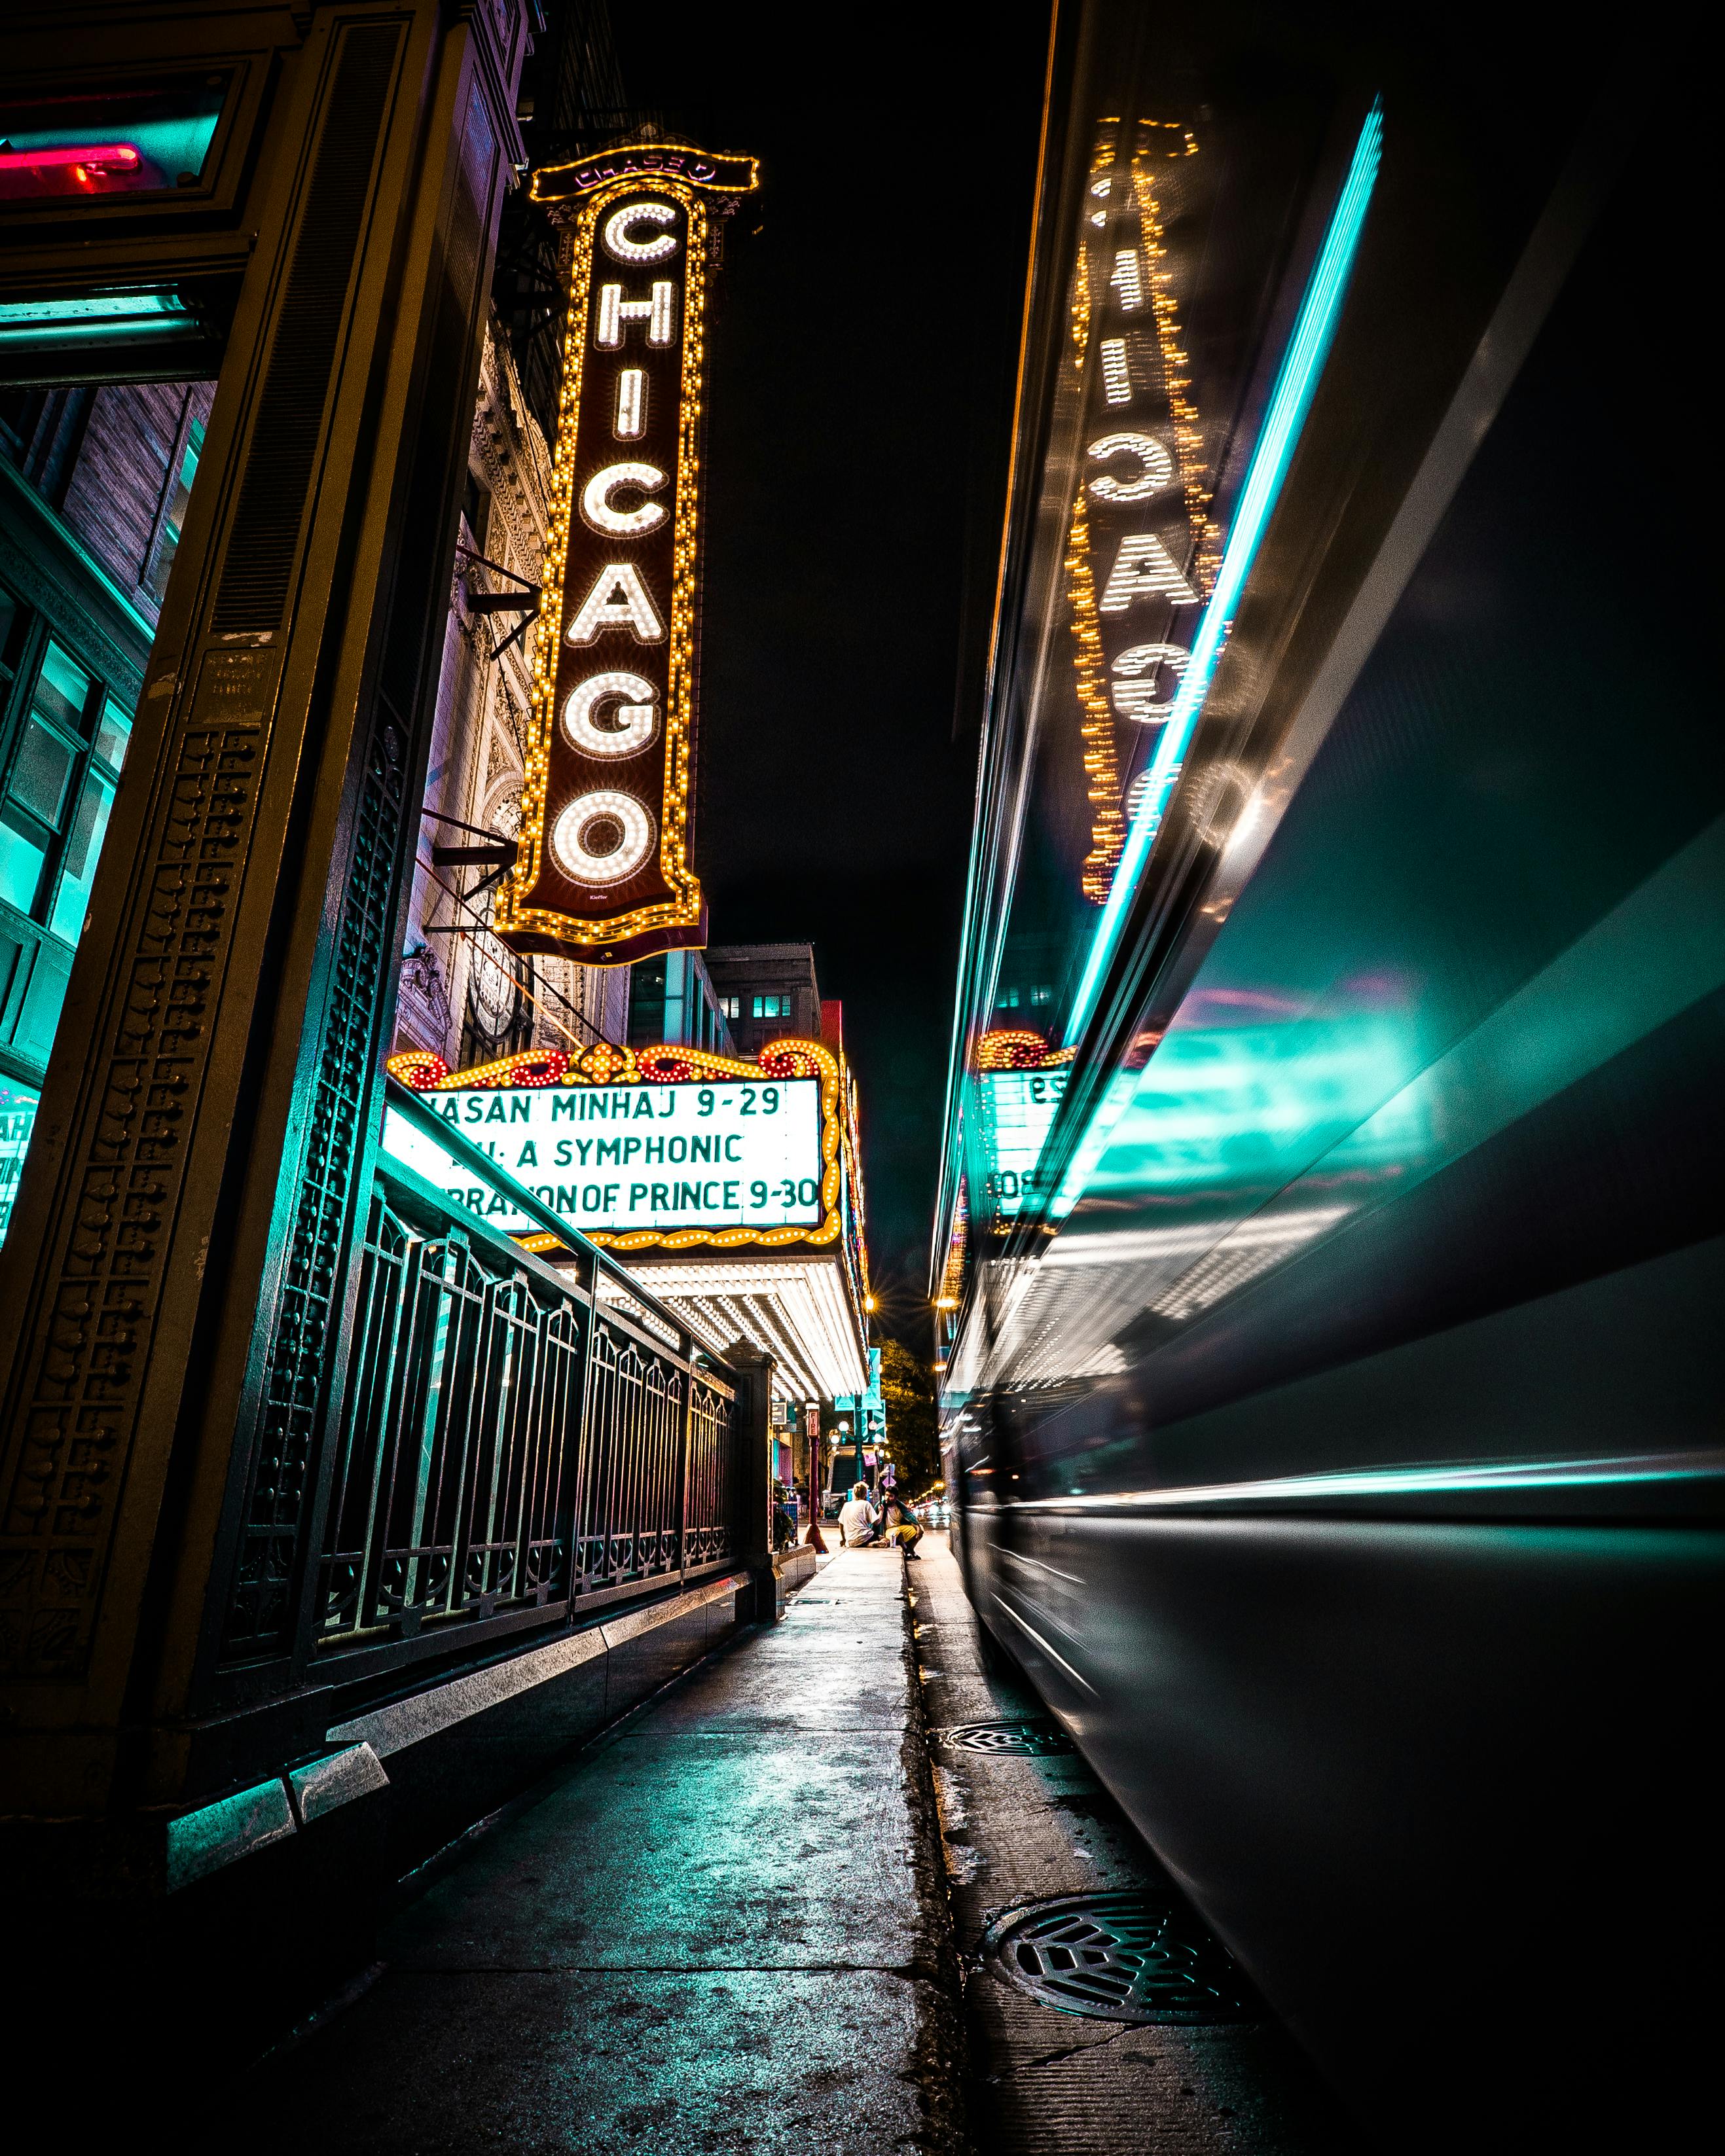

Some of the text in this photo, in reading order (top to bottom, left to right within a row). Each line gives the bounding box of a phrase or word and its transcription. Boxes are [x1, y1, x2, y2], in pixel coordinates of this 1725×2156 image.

[575, 154, 685, 188] CHASE
[551, 202, 680, 884] CHICAGO
[551, 1090, 676, 1122] MINHAJ
[697, 1087, 780, 1117] 9-29
[517, 1140, 538, 1168] A
[554, 1134, 744, 1166] SYMPHONIC
[628, 1180, 740, 1212] PRINCE
[750, 1178, 819, 1209] 9-30
